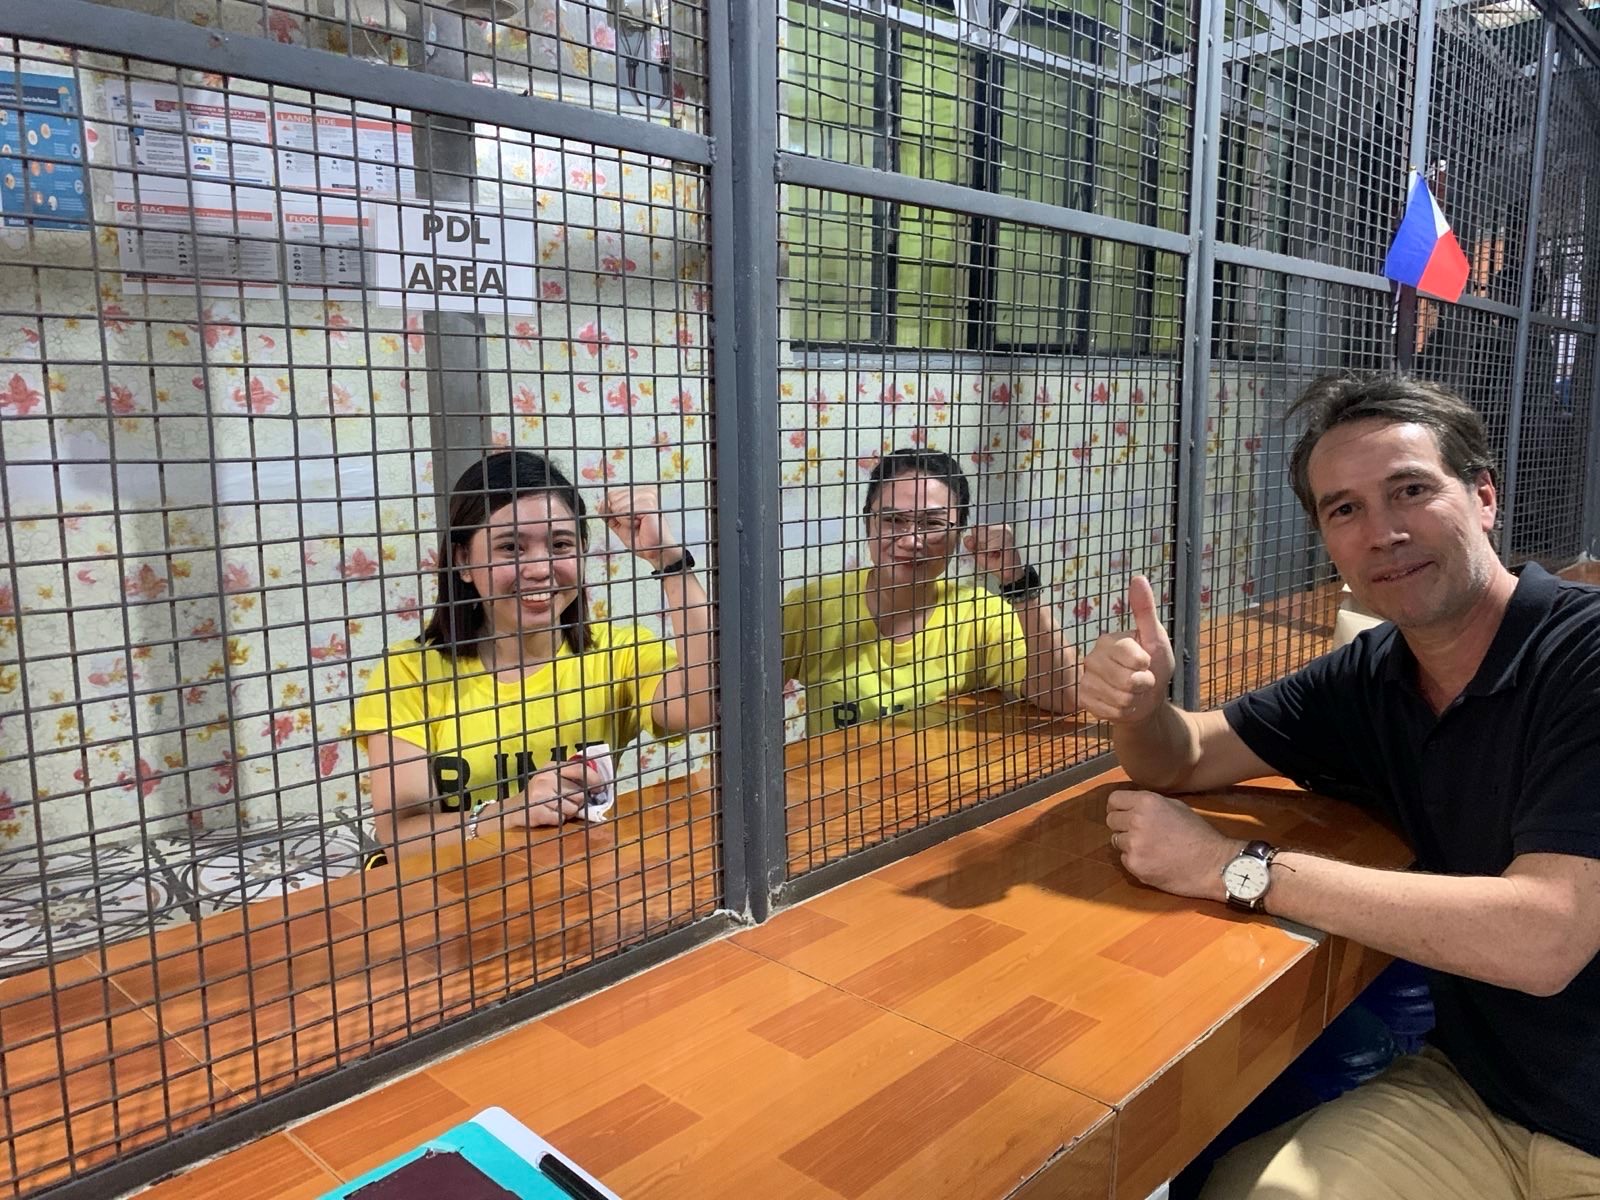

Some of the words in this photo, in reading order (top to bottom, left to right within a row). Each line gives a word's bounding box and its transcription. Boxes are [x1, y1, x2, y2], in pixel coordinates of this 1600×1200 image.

[141, 205, 165, 213] BAG
[289, 214, 320, 224] FLOO
[422, 213, 491, 245] PDL
[407, 262, 505, 294] AREA
